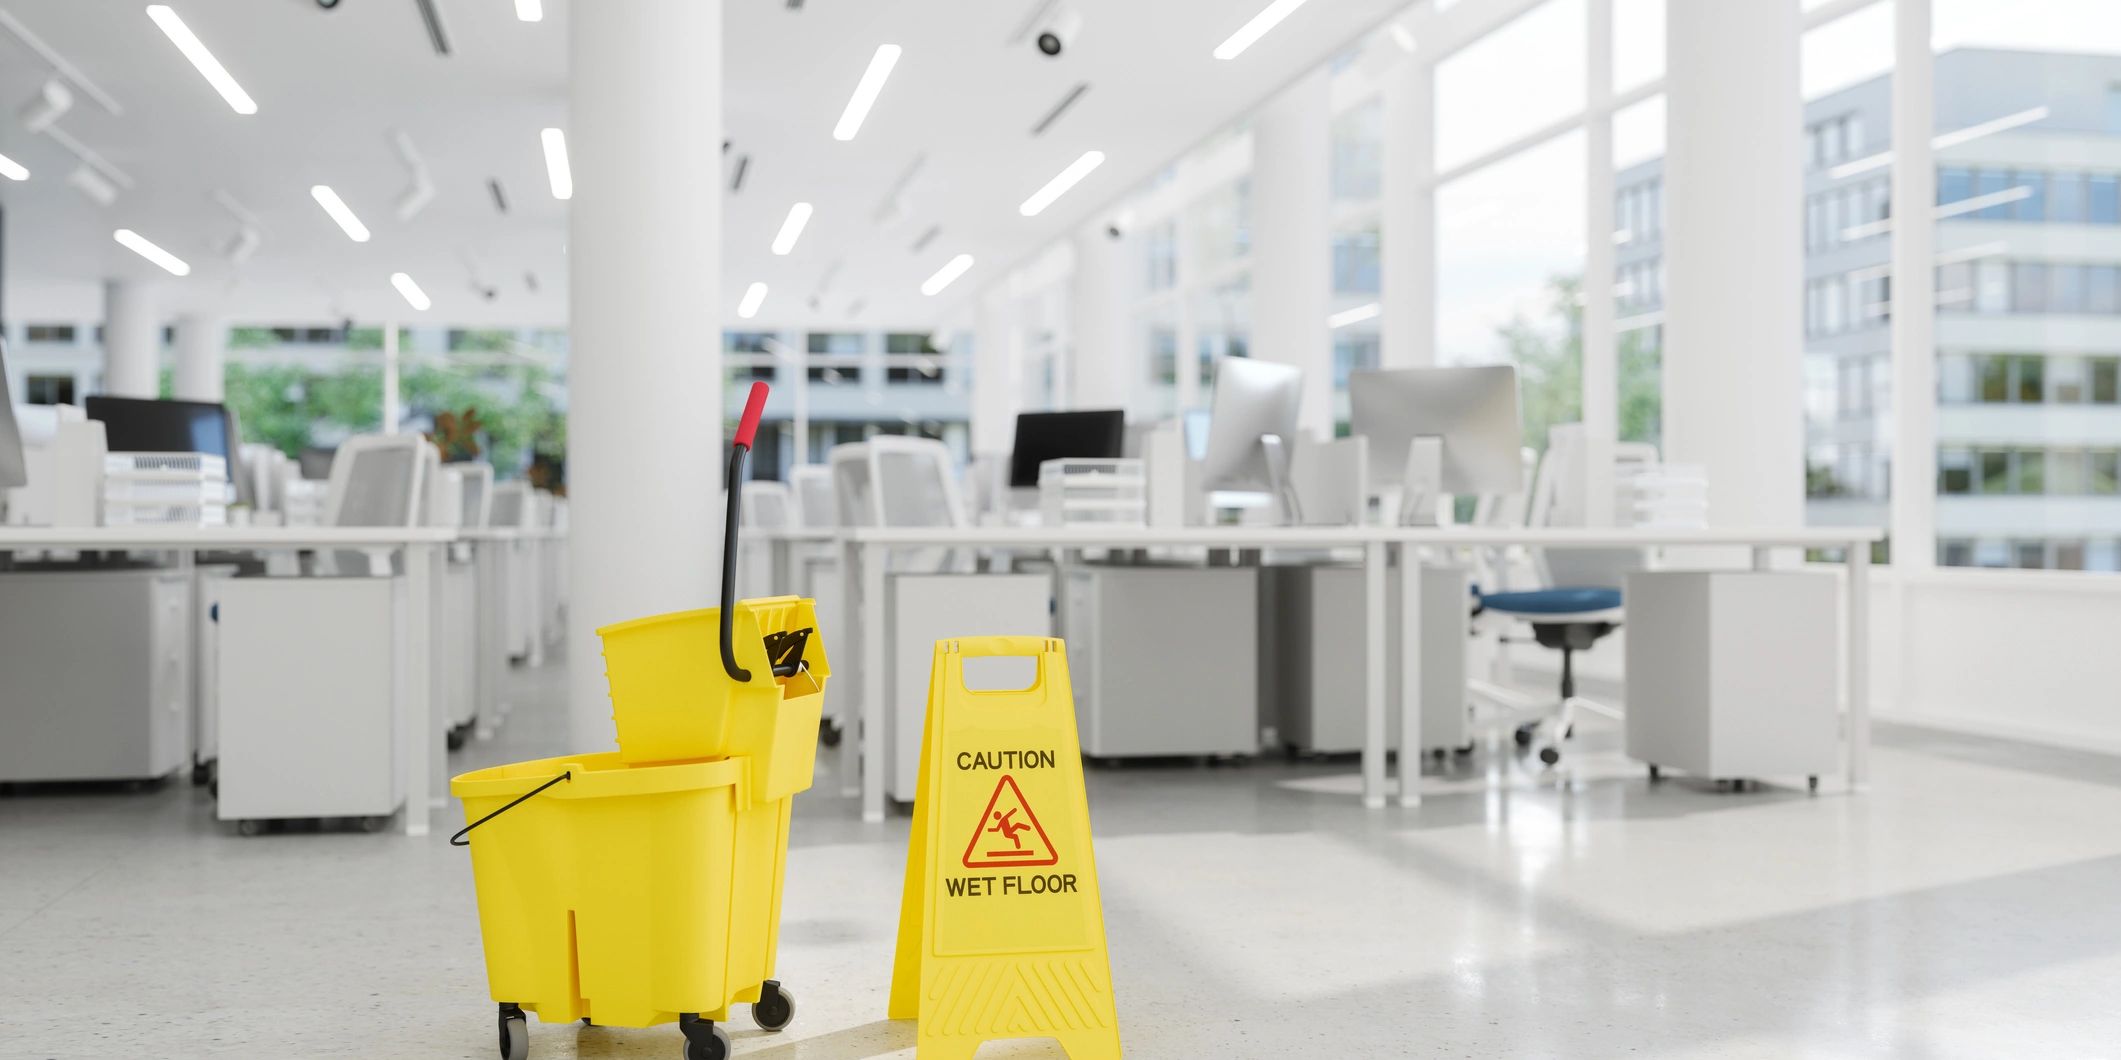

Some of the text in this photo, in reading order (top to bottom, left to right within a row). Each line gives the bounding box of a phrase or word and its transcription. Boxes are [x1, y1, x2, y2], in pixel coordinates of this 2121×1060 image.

[956, 750, 1055, 770] CAUTION
[945, 874, 1078, 897] WET FLOOR
